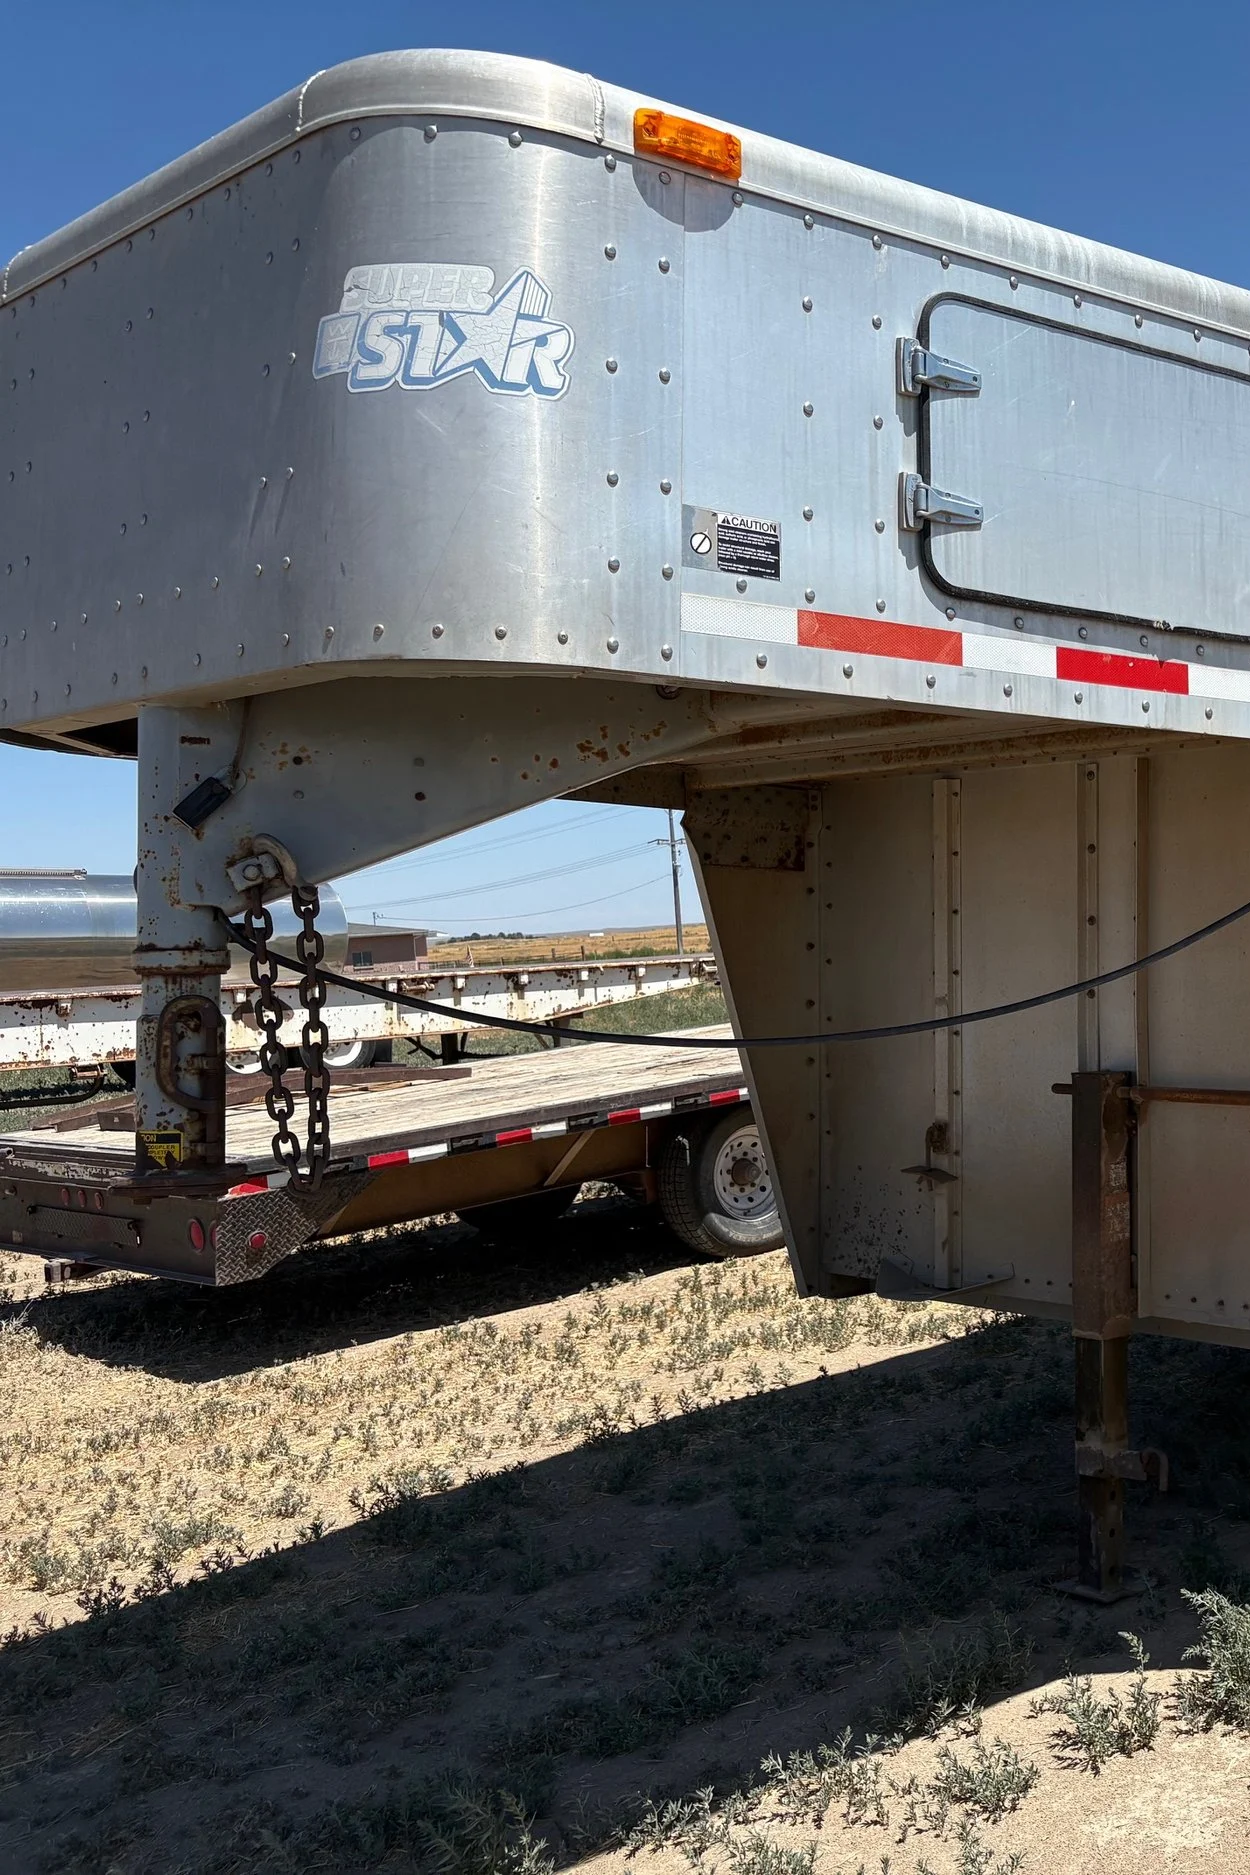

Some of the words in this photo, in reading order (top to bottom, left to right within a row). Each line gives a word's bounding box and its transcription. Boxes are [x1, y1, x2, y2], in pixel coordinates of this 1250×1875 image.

[341, 265, 495, 313] SUPER
[348, 266, 572, 399] STAR
[731, 516, 776, 533] CAUTION
